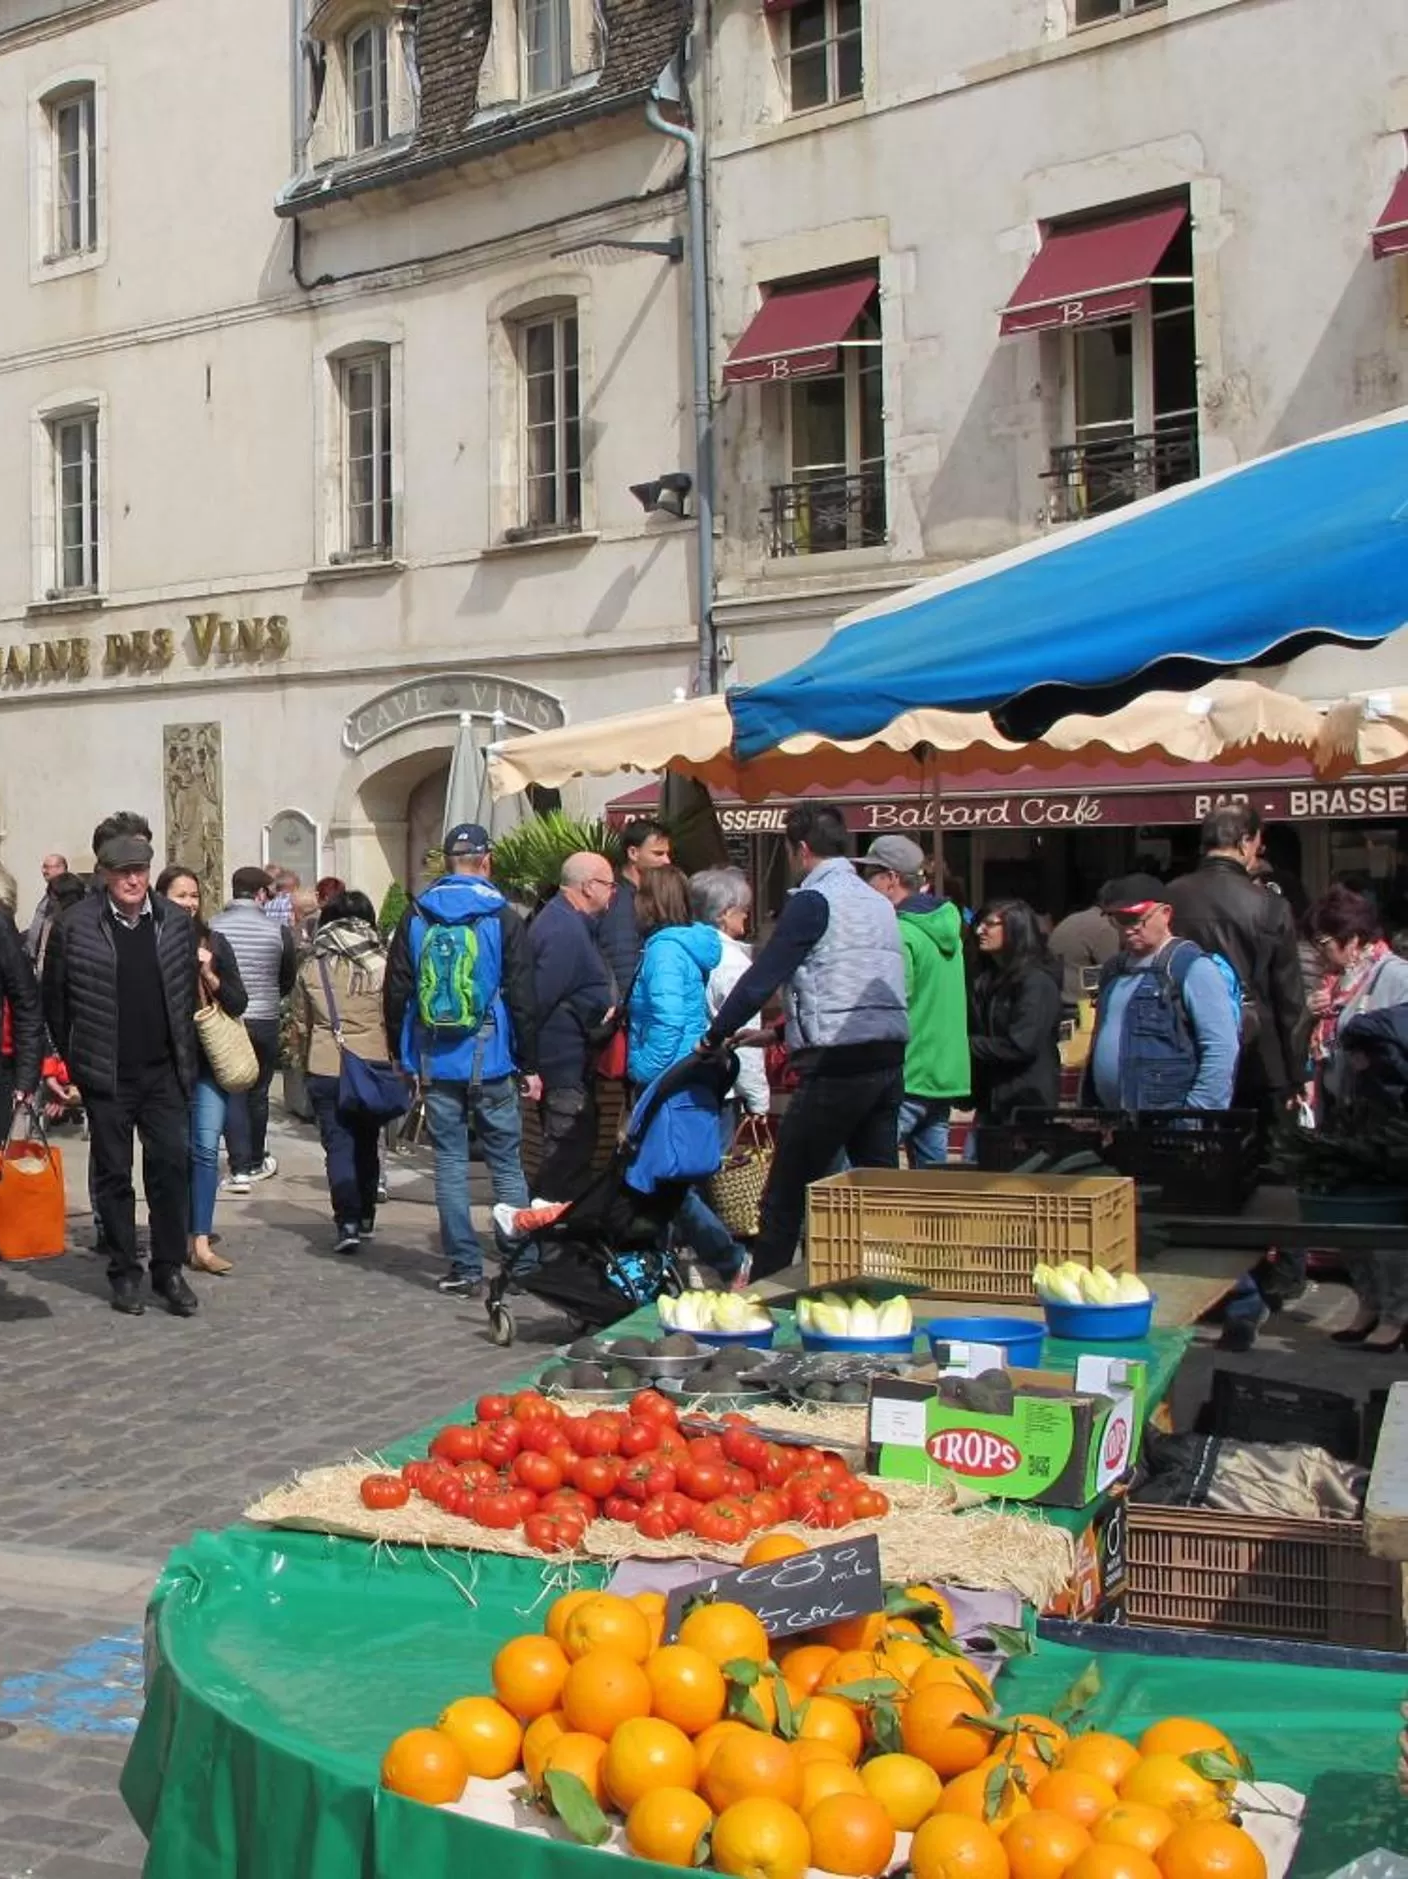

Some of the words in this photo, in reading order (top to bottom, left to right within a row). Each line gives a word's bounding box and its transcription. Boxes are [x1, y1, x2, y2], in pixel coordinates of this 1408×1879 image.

[1058, 301, 1084, 323] B
[767, 359, 790, 380] B
[105, 628, 175, 672] DES
[186, 612, 290, 664] VINS
[356, 686, 431, 737] CAVE
[469, 680, 551, 726] VINS
[716, 808, 788, 831] SSERIE
[1020, 796, 1103, 825] Café
[929, 1431, 1017, 1471] TROPS
